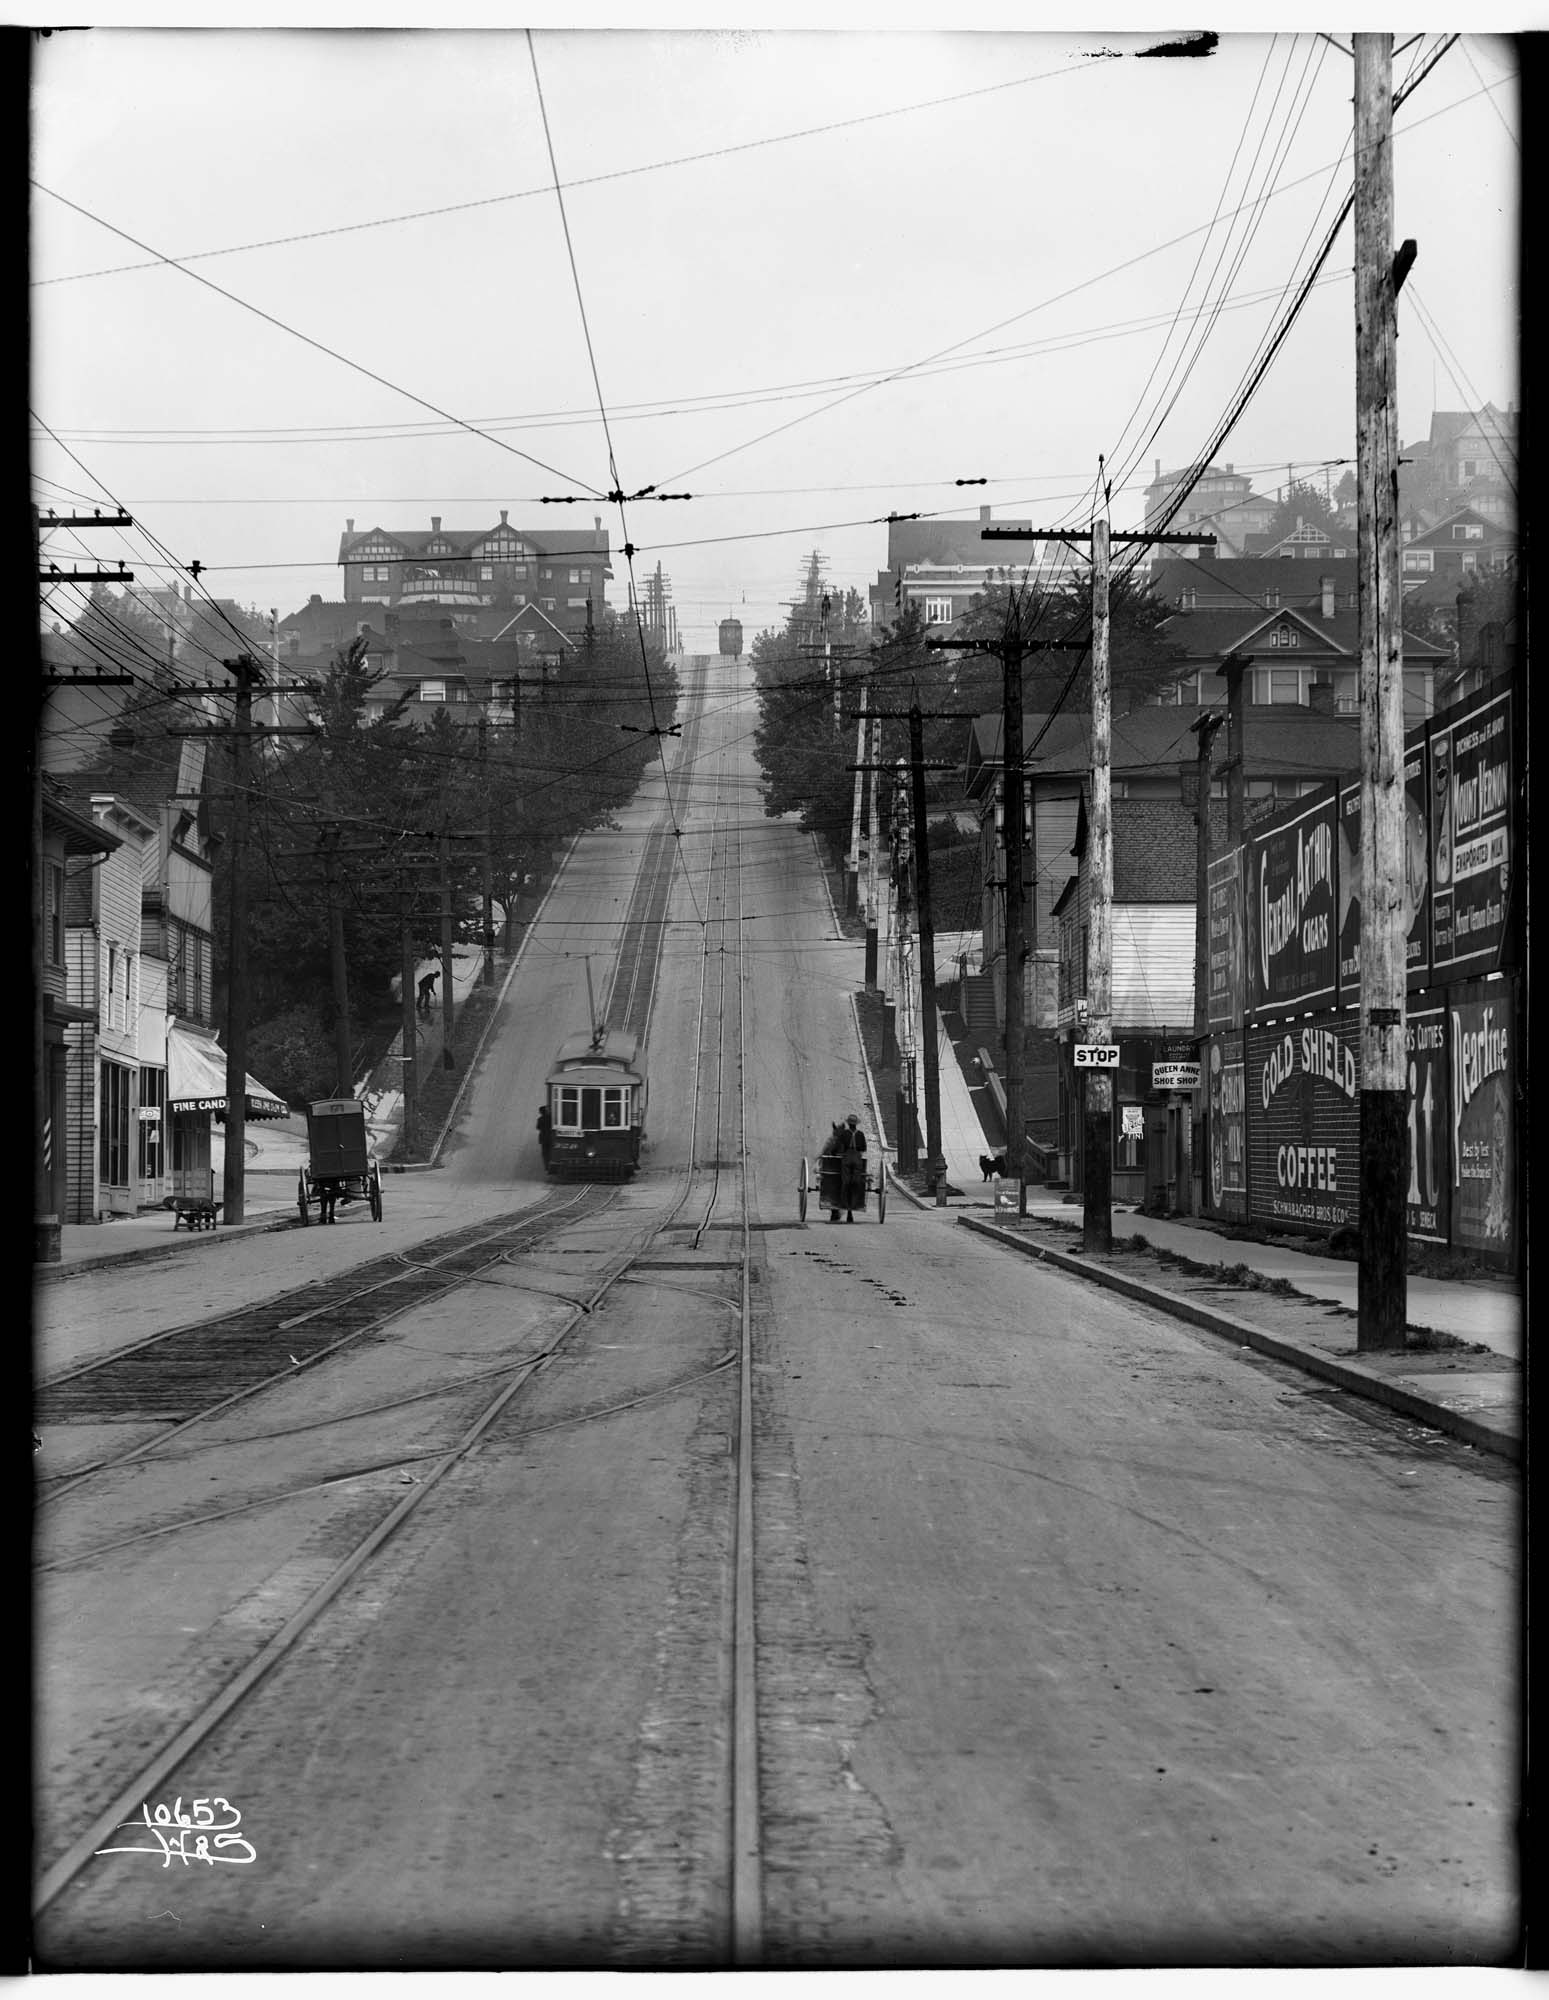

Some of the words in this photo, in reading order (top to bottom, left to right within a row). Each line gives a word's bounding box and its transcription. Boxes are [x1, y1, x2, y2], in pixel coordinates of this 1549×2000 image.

[1456, 730, 1479, 757] RICHNESS
[1453, 772, 1478, 836] MOUNT
[1478, 759, 1509, 832] VERNON
[1456, 843, 1488, 874] EVAPORATED
[1490, 835, 1504, 859] MILK
[1261, 850, 1296, 990] GENERAL
[1296, 822, 1332, 938] ARTHUR
[1303, 912, 1328, 954] CIGARS
[1076, 1049, 1118, 1063] STOP
[1154, 1065, 1178, 1076] QUEEN
[1179, 1065, 1201, 1076] ANNE
[1262, 1034, 1294, 1110] GOLD
[1301, 1027, 1356, 1098] SHIELD
[1154, 1077, 1174, 1085] SHOE
[1176, 1077, 1198, 1085] SHOP
[1452, 1007, 1508, 1187] Pearline
[173, 1101, 196, 1113] FINE
[198, 1099, 226, 1112] CAND
[1408, 1061, 1439, 1207] it
[1277, 1145, 1337, 1191] COFFEE
[1273, 1199, 1315, 1219] SCHWABACHER
[1316, 1205, 1331, 1222] BROS
